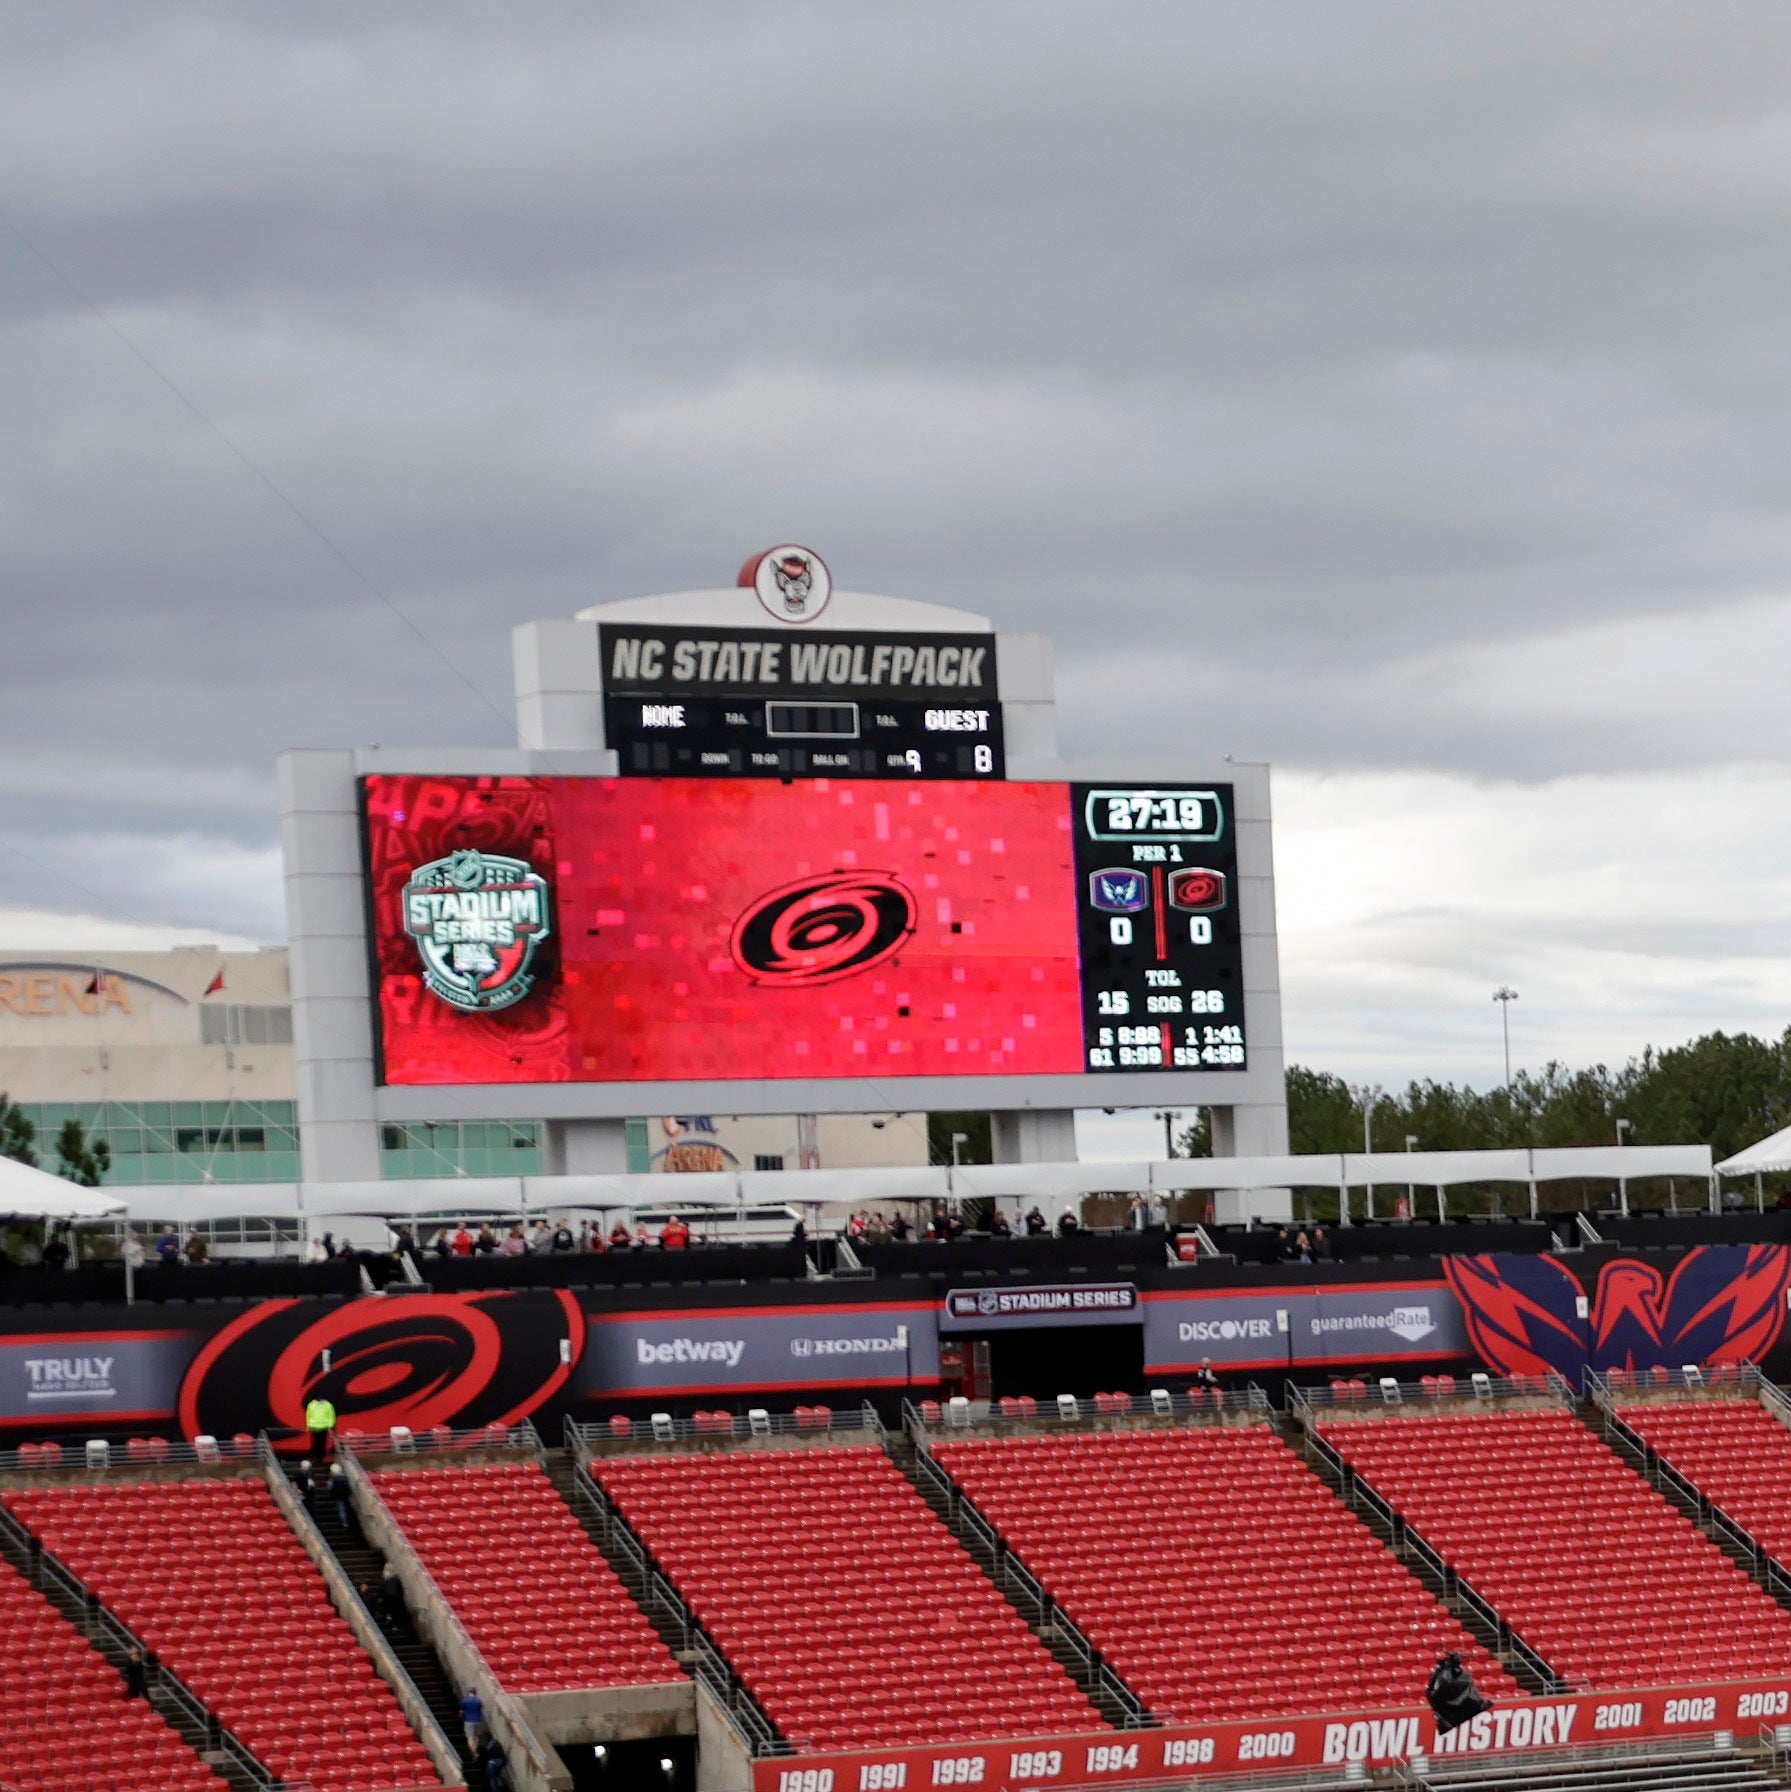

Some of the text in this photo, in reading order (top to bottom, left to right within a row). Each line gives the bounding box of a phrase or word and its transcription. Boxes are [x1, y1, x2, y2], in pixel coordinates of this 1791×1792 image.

[612, 639, 986, 686] NC STATE WOLFPACK
[925, 709, 990, 732] GUEST
[1108, 798, 1203, 831] 27:19
[1132, 844, 1183, 862] PER 1
[410, 889, 539, 926] STADIUM
[433, 920, 515, 945] SERIES
[1110, 917, 1132, 945] 0
[1189, 916, 1212, 945] 0
[1145, 970, 1182, 987] TOL
[1098, 990, 1224, 1014] 15 SOG 26
[1185, 1025, 1243, 1045] 1 1:41
[1089, 1048, 1115, 1066] 61
[1000, 1290, 1132, 1311] STADIUM SERIES
[1179, 1318, 1273, 1341] DISCOVER
[1311, 1311, 1428, 1334] guaranteed Rate
[636, 1338, 745, 1367] betway
[814, 1336, 902, 1354] HONDA
[24, 1357, 115, 1381] TRULY
[1595, 1703, 1643, 1729] 2001
[1664, 1698, 1716, 1724] 2002
[1737, 1691, 1789, 1718] 2003
[1238, 1732, 1296, 1760] 2000
[1323, 1704, 1578, 1763] BOWL HISTORY
[1010, 1750, 1062, 1779] 1993
[1086, 1744, 1139, 1773] 1994
[1163, 1738, 1216, 1767] 1998
[859, 1763, 907, 1791] 1991
[932, 1757, 986, 1786] 1992
